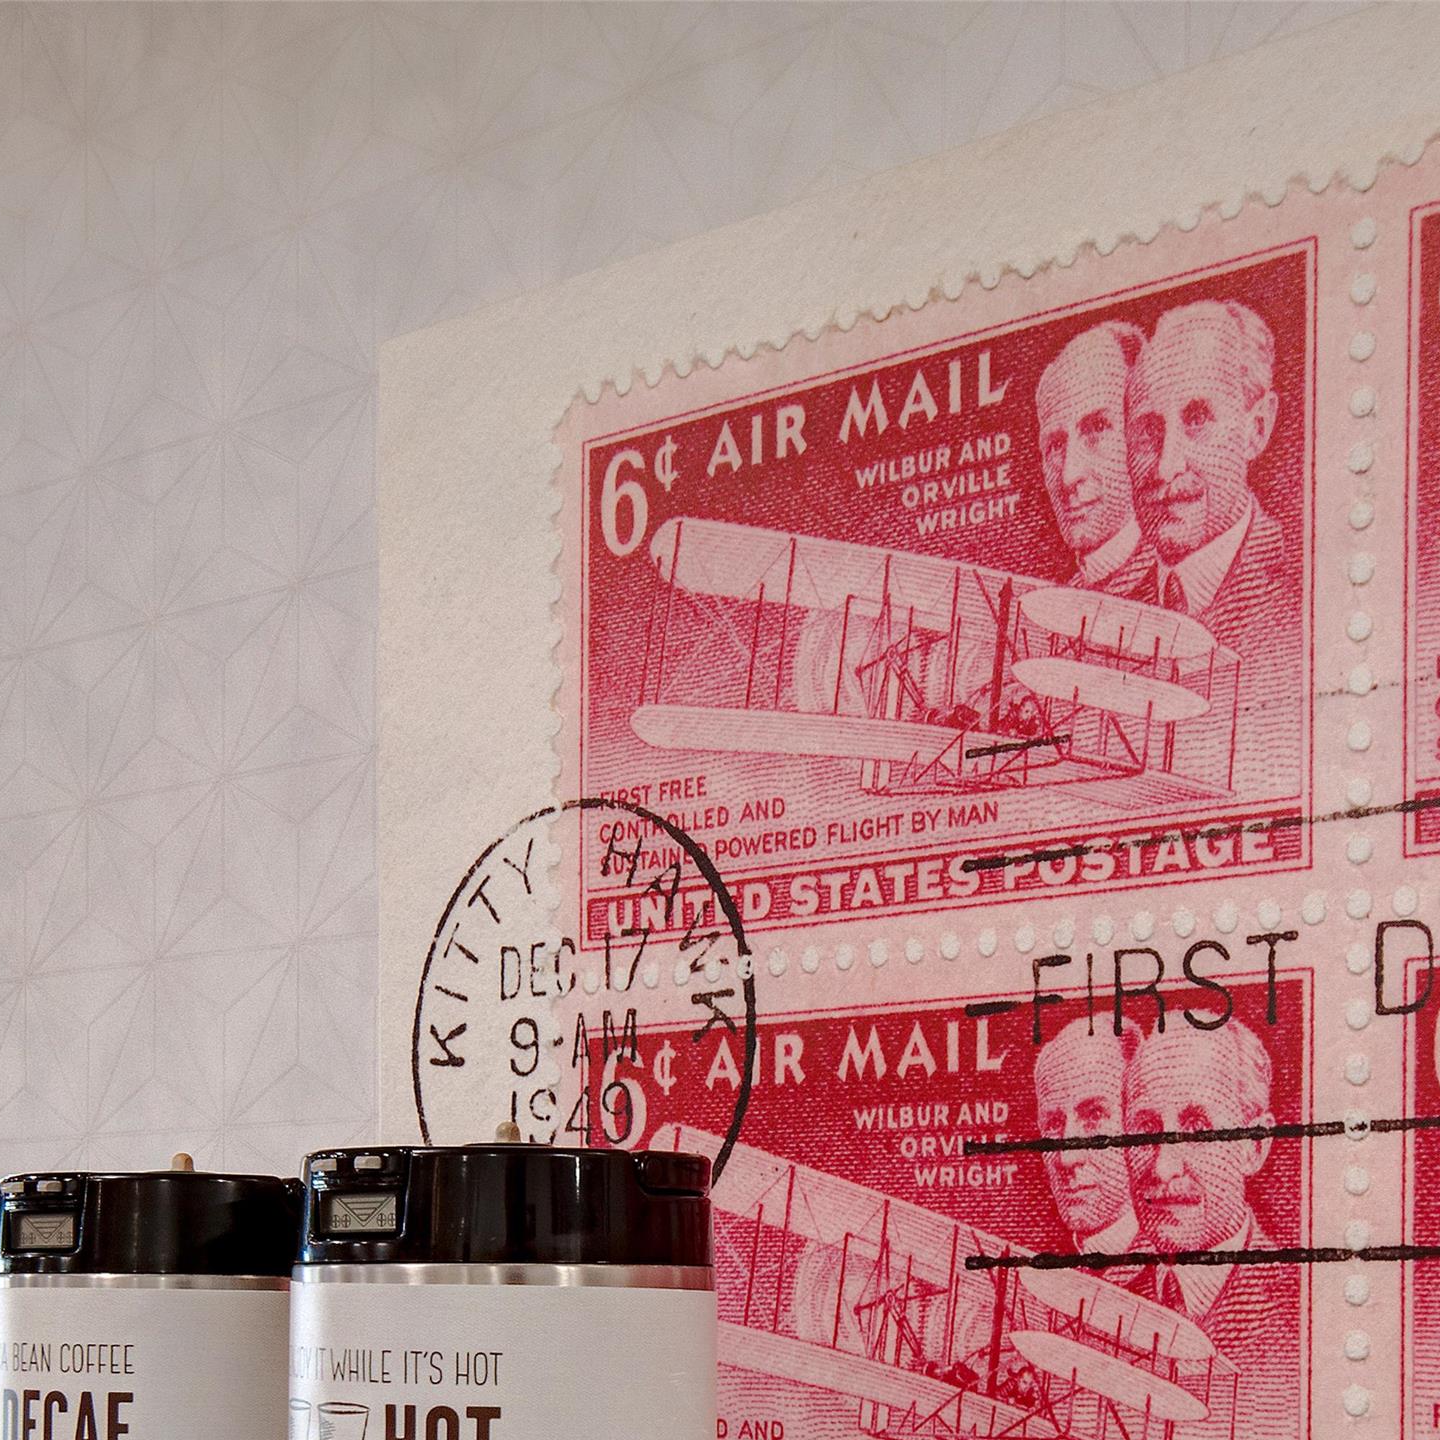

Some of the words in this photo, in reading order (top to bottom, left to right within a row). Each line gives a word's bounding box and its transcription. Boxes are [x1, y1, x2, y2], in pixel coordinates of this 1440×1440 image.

[707, 405, 808, 477] AIR
[839, 350, 1011, 443] MAIL
[855, 447, 950, 489] WILBUR
[959, 432, 1011, 467] AND
[901, 464, 1011, 508] ORVILLE
[916, 495, 1020, 536] WRIGHT
[600, 783, 651, 810] FIRST
[660, 776, 707, 801] FREE
[599, 806, 728, 844] CONTROLLED
[740, 797, 786, 823] AND
[715, 826, 817, 860] POWERED
[827, 813, 904, 846] FLIGHT
[912, 808, 941, 833] BY
[948, 801, 999, 827] MAN
[607, 882, 772, 932] UNITED
[790, 855, 980, 917] STATES
[1004, 817, 1276, 891] POSTAGE
[429, 837, 533, 1068] KITTY
[500, 937, 577, 1001] DEC
[605, 928, 649, 991] 17
[1032, 930, 1298, 1044] FIRST
[706, 1034, 807, 1091] AIR
[837, 1019, 1010, 1083] MAIL
[854, 1105, 949, 1132] WILBUR
[958, 1101, 1009, 1124] AND
[900, 1133, 1009, 1158] ORVI
[913, 1164, 1018, 1188] WRIGHT
[13, 1343, 51, 1372] BEAN
[60, 1344, 135, 1375] COFFEE
[330, 1349, 392, 1385] WHILE
[403, 1350, 444, 1386] IT'S
[455, 1352, 504, 1387] HOT
[737, 1420, 785, 1440] AND
